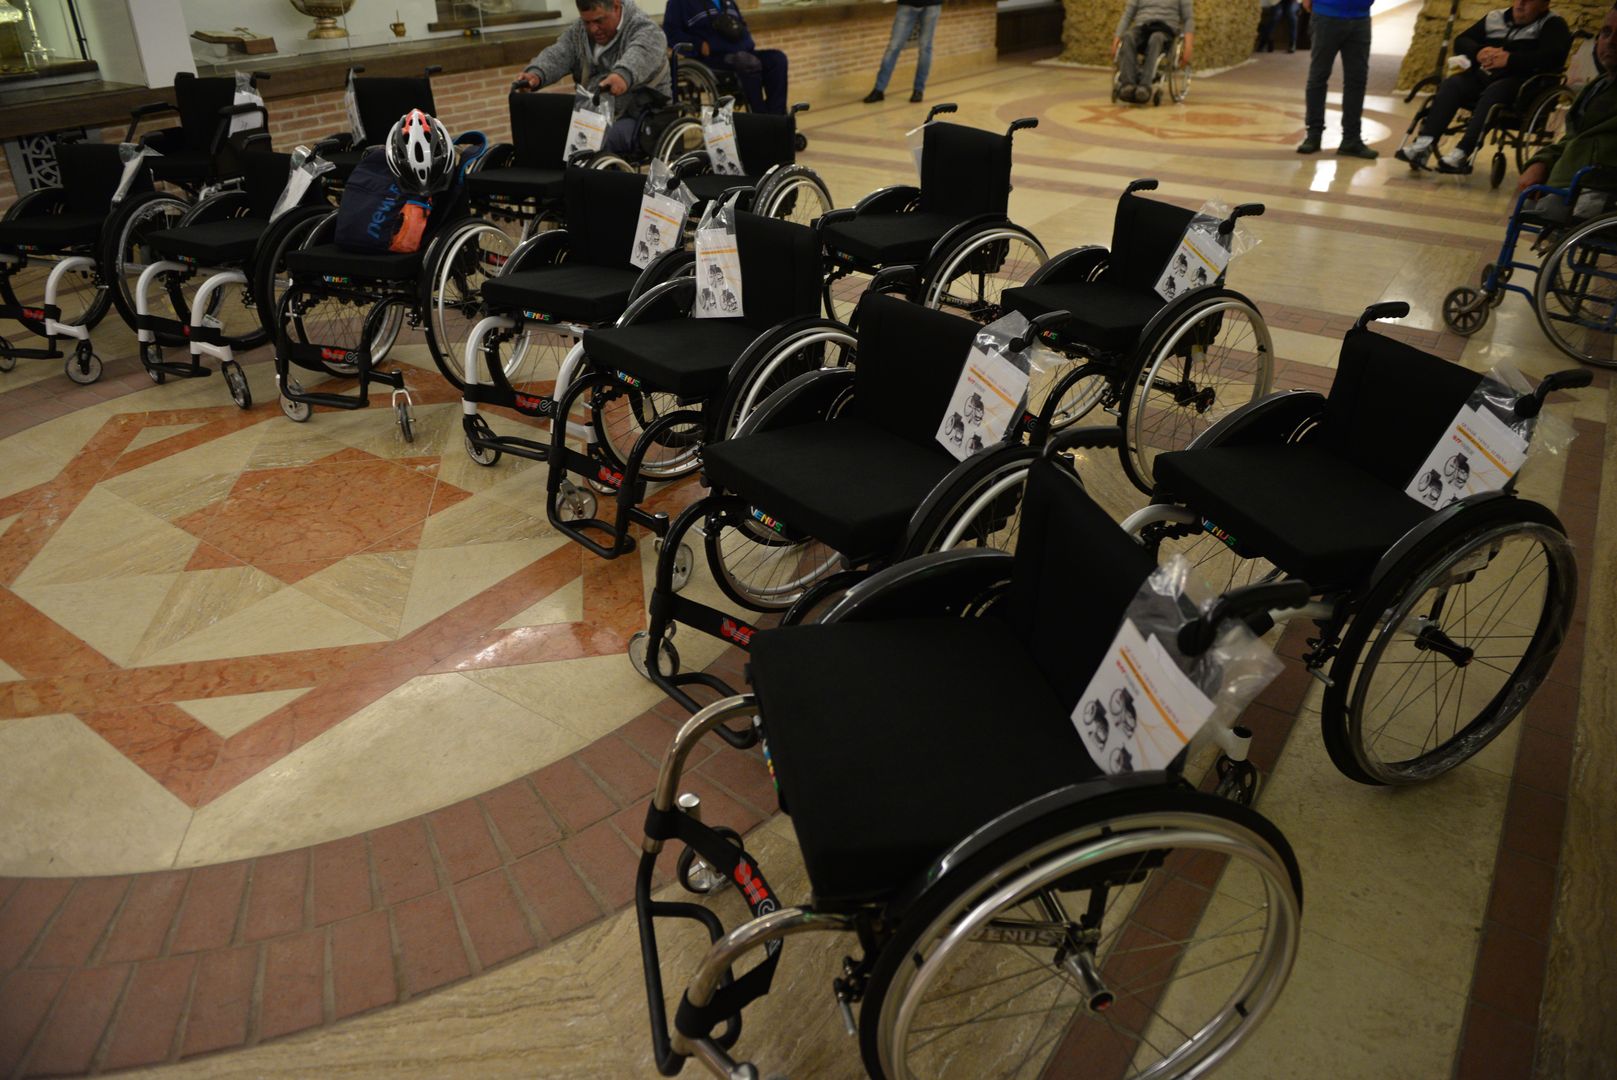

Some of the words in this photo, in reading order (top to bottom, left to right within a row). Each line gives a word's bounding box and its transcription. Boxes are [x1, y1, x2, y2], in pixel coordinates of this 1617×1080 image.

[523, 309, 552, 322] VENUS
[615, 369, 641, 389] VENUS
[750, 505, 784, 534] VENUS
[1201, 514, 1237, 547] VENUS
[971, 928, 1056, 947] VENUS
